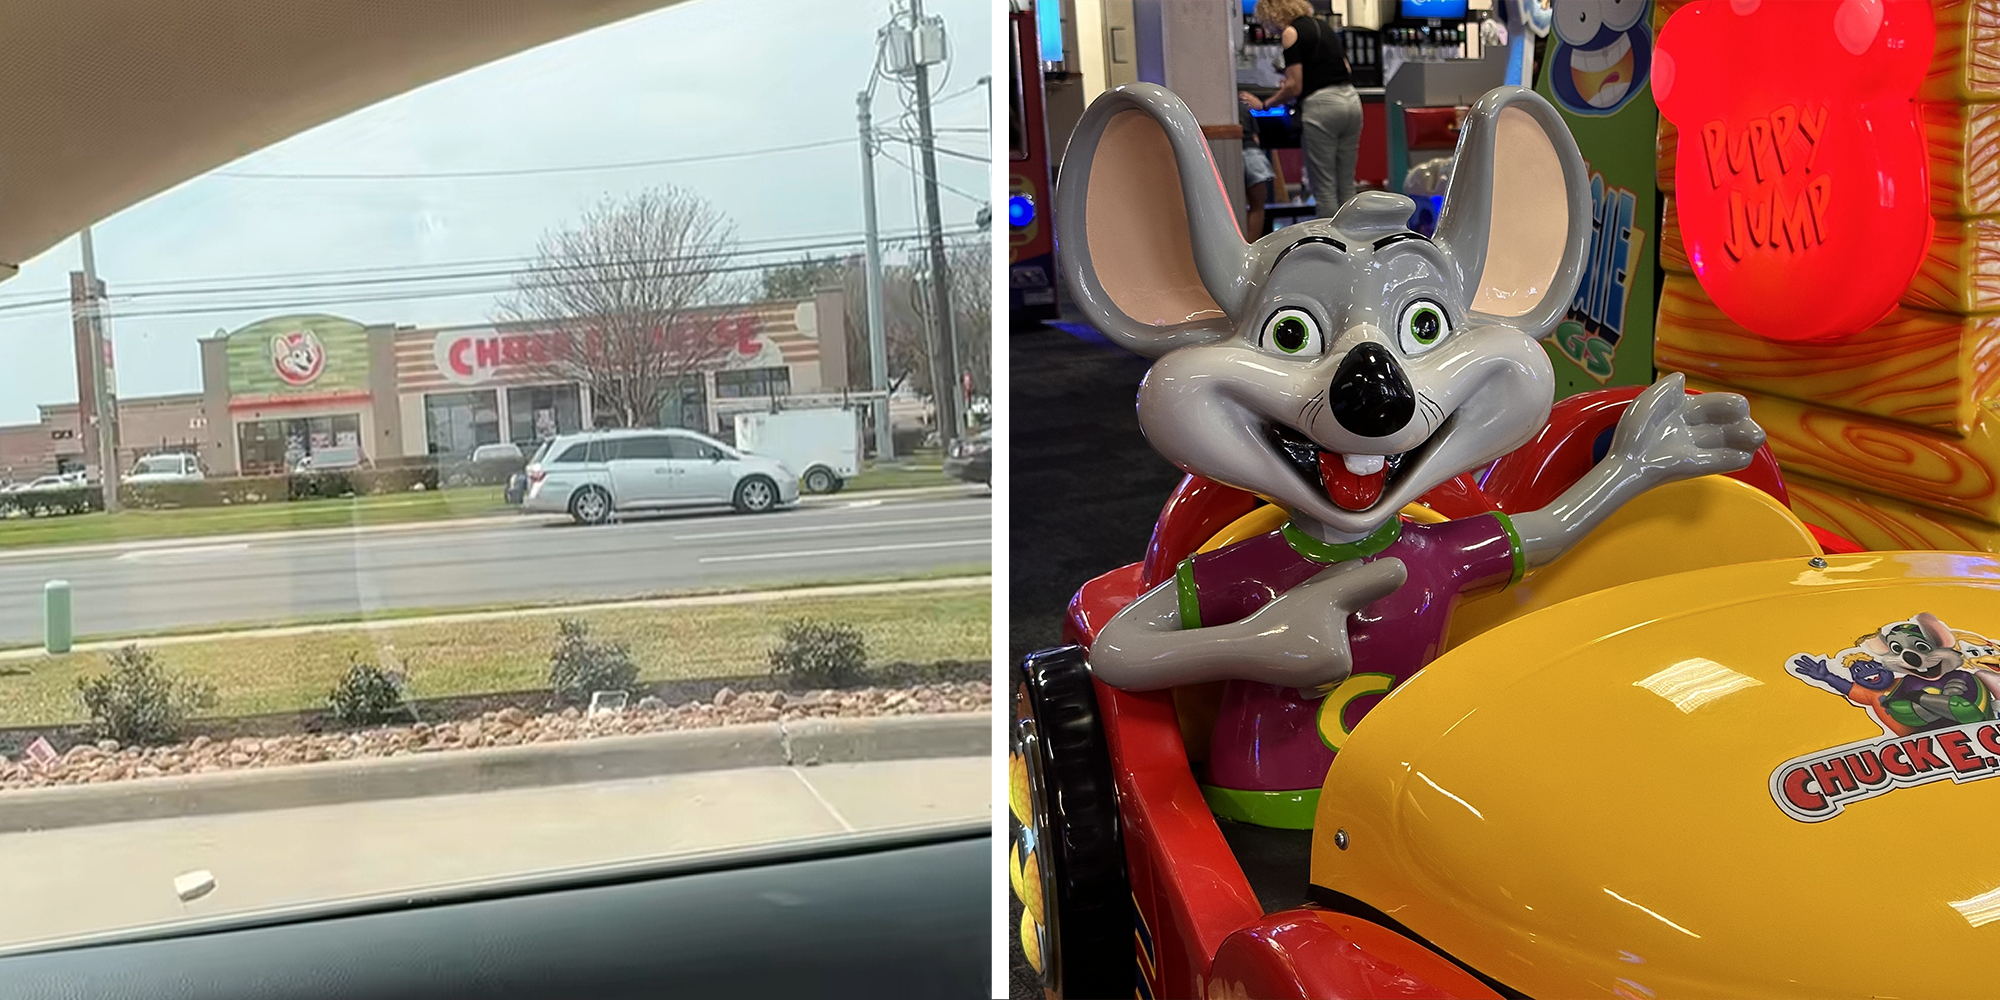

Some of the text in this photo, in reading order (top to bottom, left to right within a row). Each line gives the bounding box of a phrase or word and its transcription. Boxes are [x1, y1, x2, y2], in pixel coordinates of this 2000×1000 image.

[1702, 104, 1829, 190] PUPPY
[1571, 166, 1636, 336] GIE
[1724, 173, 1832, 263] JUMP
[1550, 320, 1613, 376] GS
[1783, 735, 1950, 811] CHUCK
